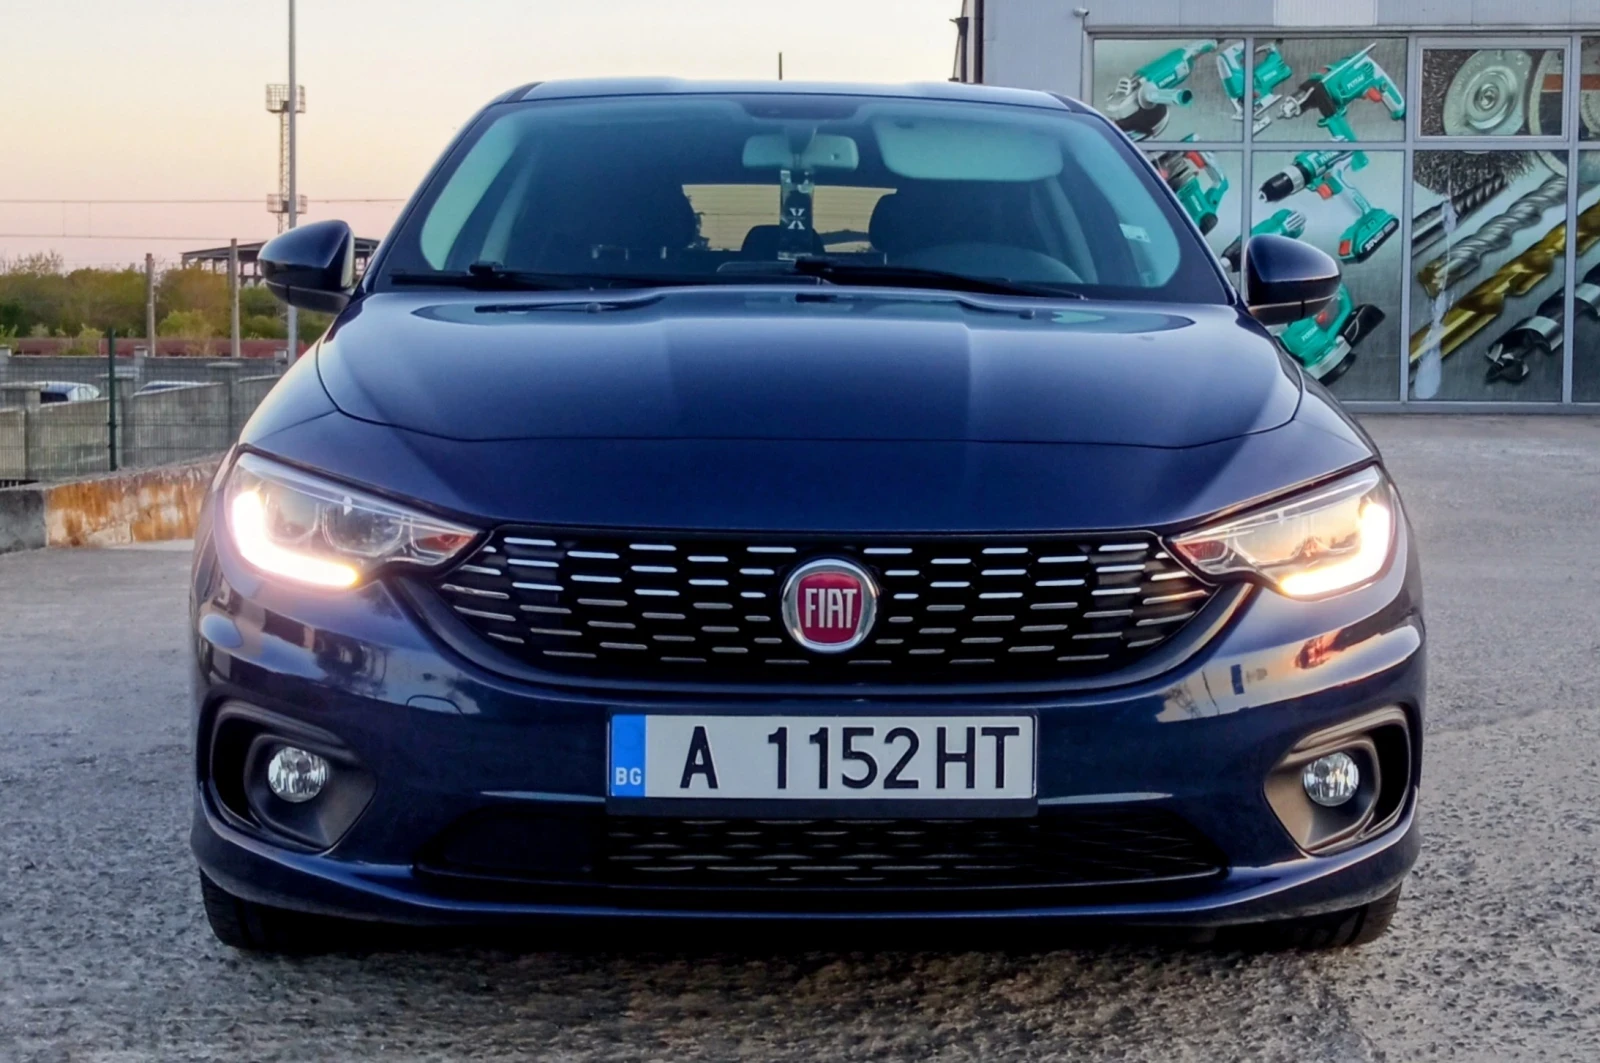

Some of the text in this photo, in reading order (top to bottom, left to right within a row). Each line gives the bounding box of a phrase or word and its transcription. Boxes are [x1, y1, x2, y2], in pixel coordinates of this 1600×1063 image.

[805, 588, 858, 629] FIAT
[615, 767, 642, 786] BG
[680, 726, 718, 789] A
